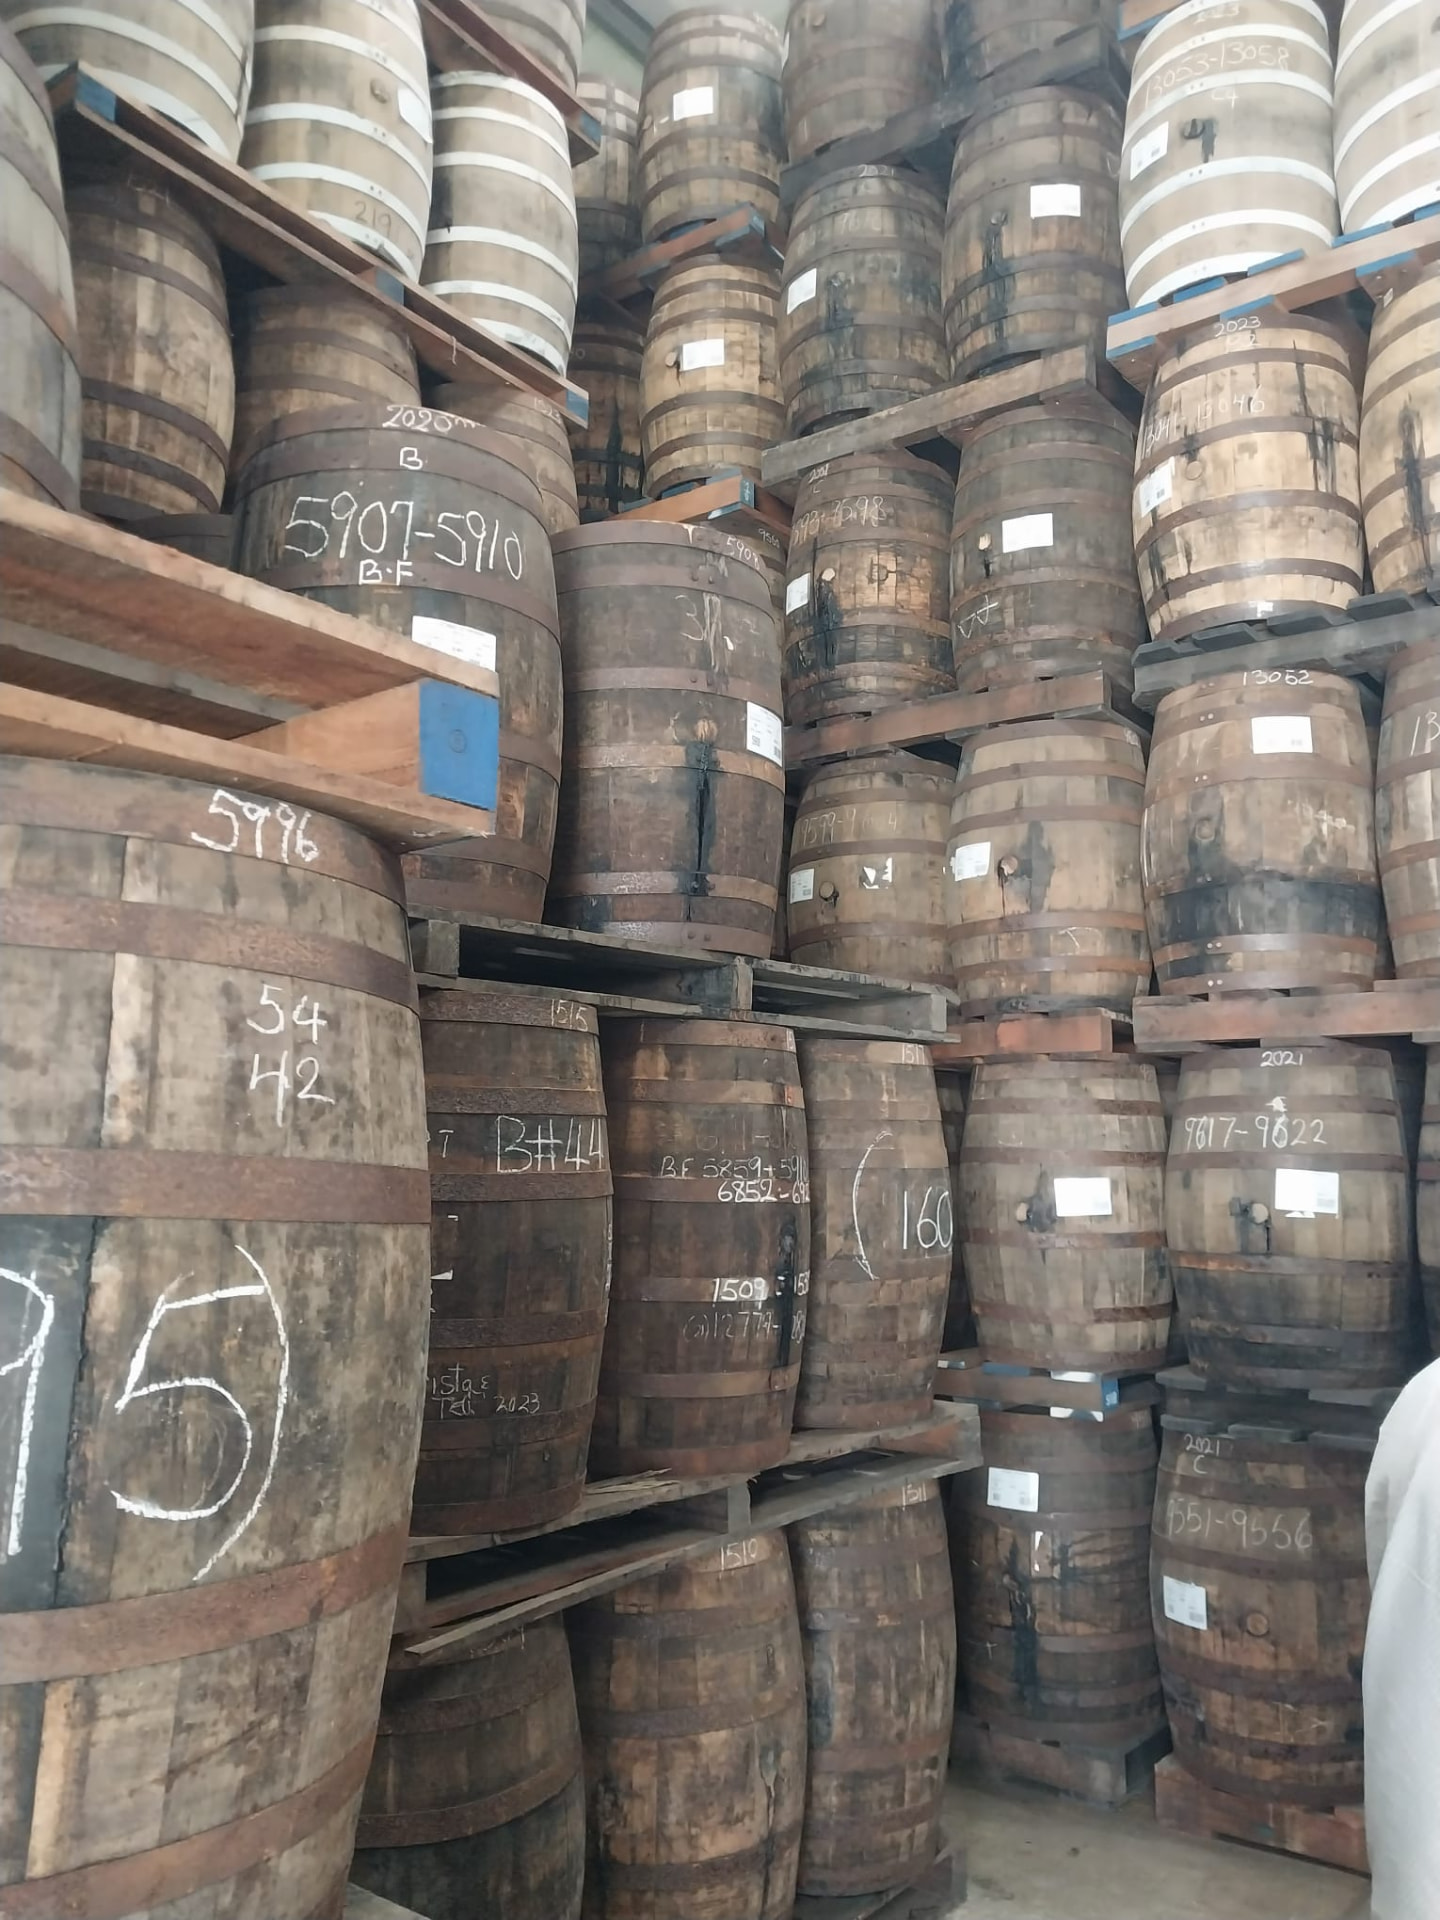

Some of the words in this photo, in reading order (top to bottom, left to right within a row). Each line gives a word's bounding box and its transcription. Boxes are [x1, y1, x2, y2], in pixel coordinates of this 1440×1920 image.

[1214, 315, 1262, 338] 2023
[400, 446, 424, 470] B
[284, 491, 523, 581] 5907-5910
[1242, 669, 1314, 686] 13052
[190, 789, 319, 864] 5996
[246, 984, 328, 1045] 54
[551, 998, 589, 1032] 1515
[1260, 1050, 1304, 1067] 2021
[250, 1050, 336, 1128] 42
[497, 1114, 604, 1174] B#44
[902, 1186, 953, 1250] 160
[493, 1392, 540, 1414] 2023
[1184, 1433, 1220, 1457] 2021
[1193, 1454, 1208, 1475] C
[719, 1537, 758, 1574] 1510
